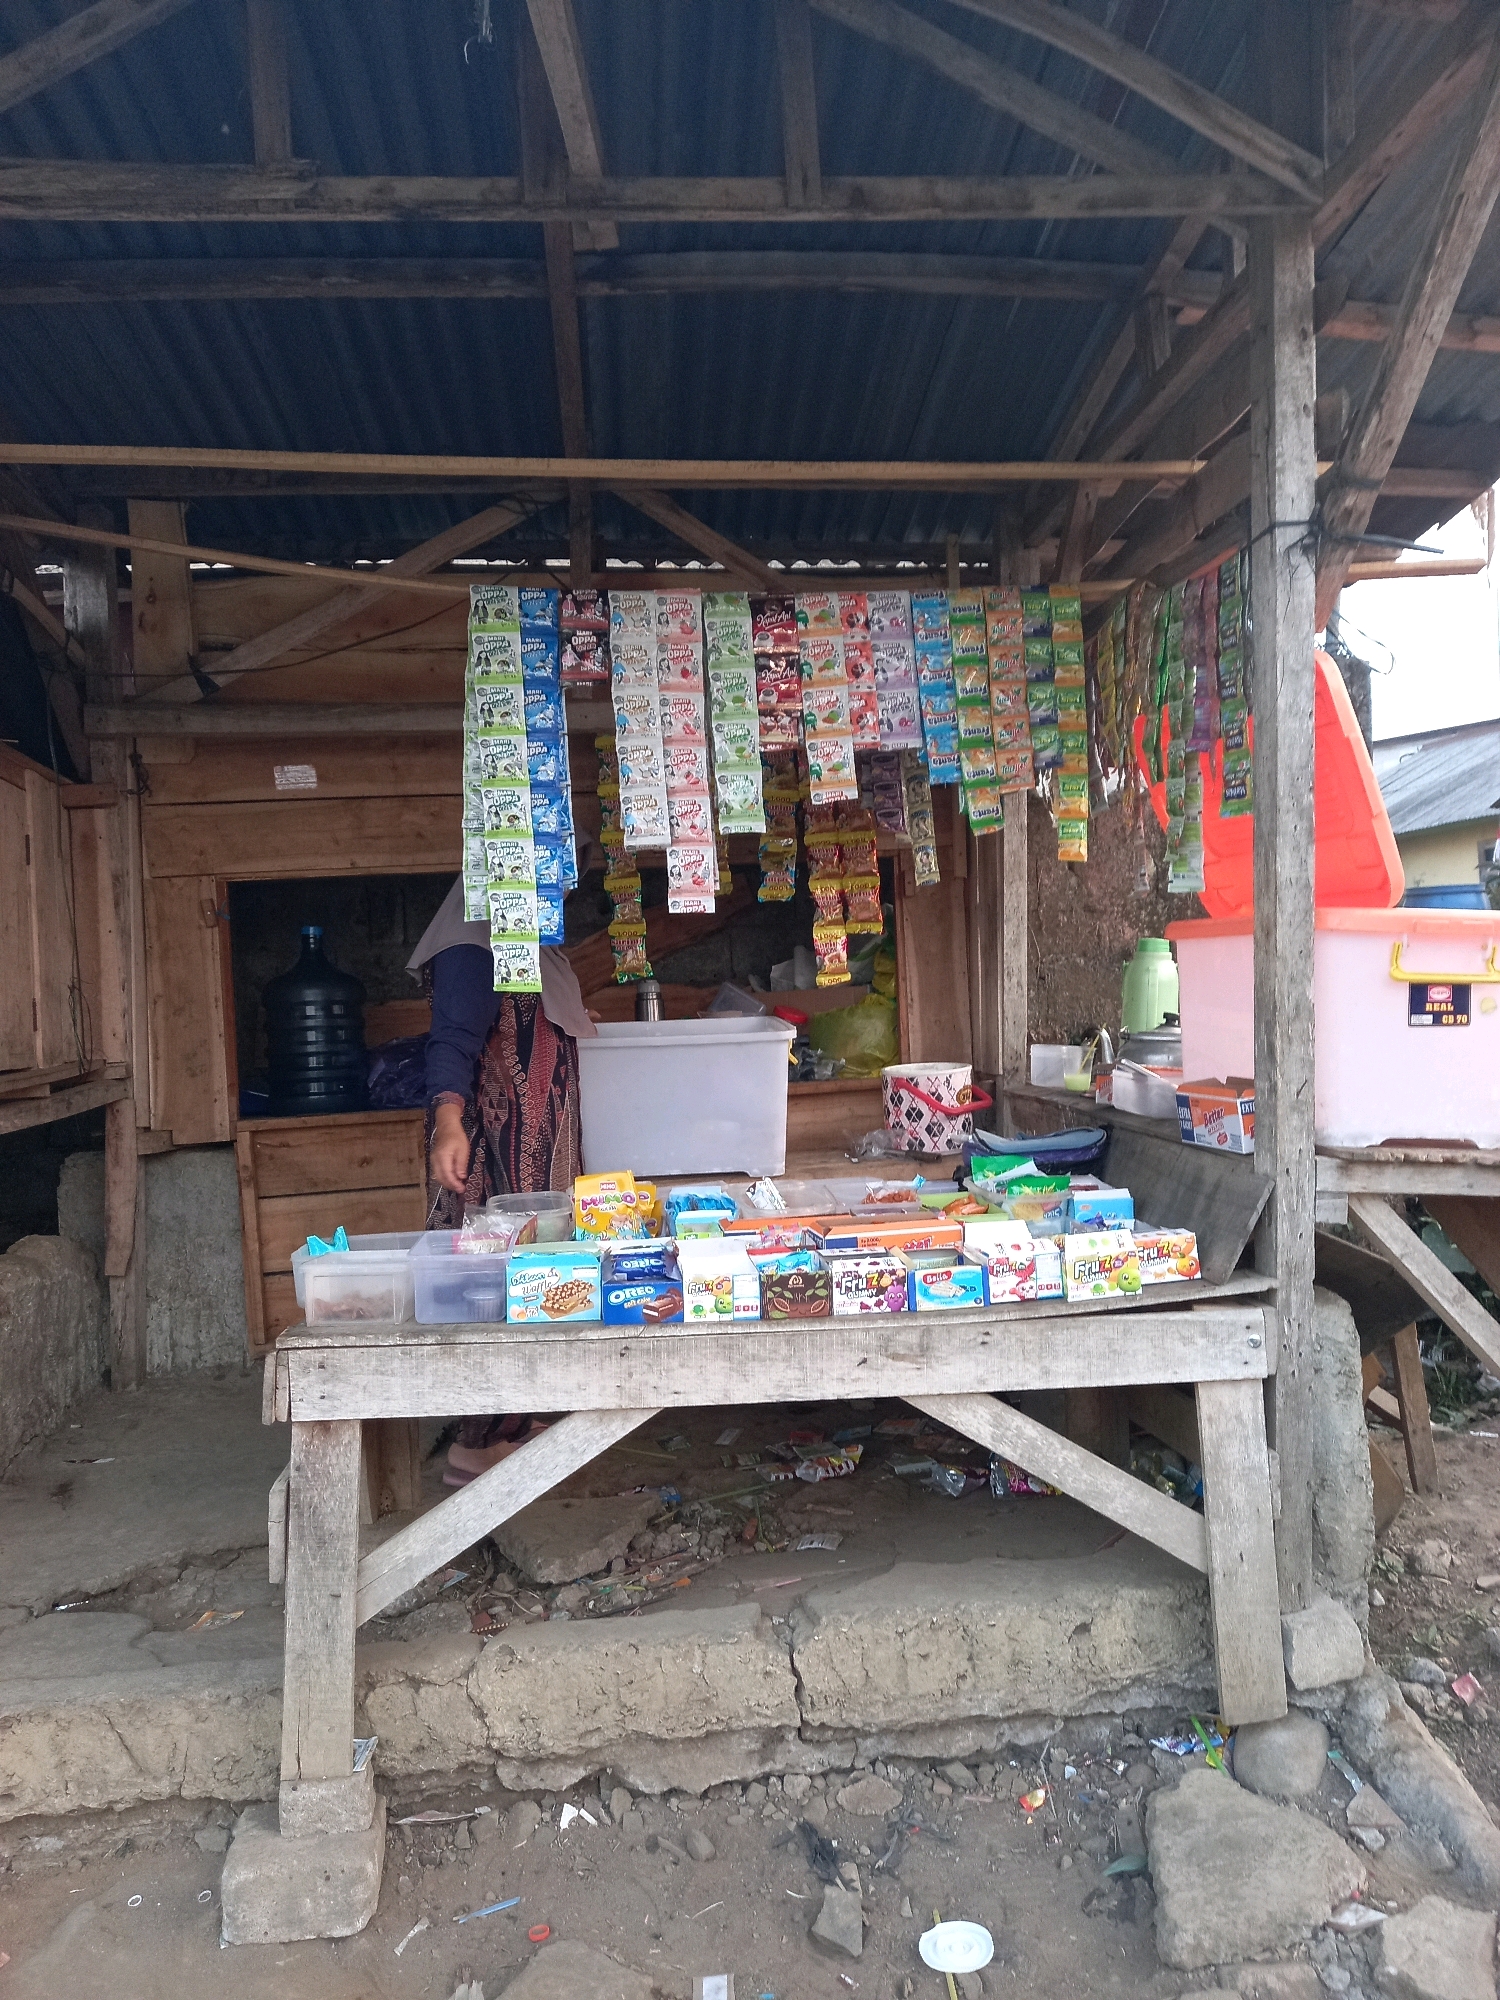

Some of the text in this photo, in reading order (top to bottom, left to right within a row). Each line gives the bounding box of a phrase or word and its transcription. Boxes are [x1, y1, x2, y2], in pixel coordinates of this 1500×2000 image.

[481, 591, 507, 600] OPPA
[522, 592, 546, 600] OPPA
[620, 600, 646, 609] OPPA
[804, 596, 829, 605] OPPA
[667, 604, 692, 612] OPPA
[572, 636, 597, 646] OPPA
[484, 641, 509, 651] OPPA
[522, 643, 546, 653] OPPA
[809, 646, 834, 655] OPPA
[622, 651, 647, 659] OPPA
[668, 651, 693, 659] OPPA
[721, 678, 747, 687] OPPA
[487, 692, 512, 703] OPPA
[813, 696, 838, 706] OPPA
[624, 701, 649, 709] OPPA
[670, 704, 695, 713] OPPA
[490, 745, 516, 755] OPPA
[628, 751, 653, 760] OPPA
[671, 755, 697, 764] OPPA
[494, 796, 519, 806] OPPA
[532, 800, 549, 808] PPA
[632, 801, 657, 809] OPPA
[675, 806, 701, 815] OPPA
[497, 847, 523, 857] OPPA
[679, 856, 704, 865] OPPA
[502, 899, 526, 908] OPPA
[504, 950, 529, 959] OPPA
[1426, 1003, 1454, 1012] REAL
[1457, 1015, 1468, 1024] 70
[608, 1286, 656, 1305] OREO
